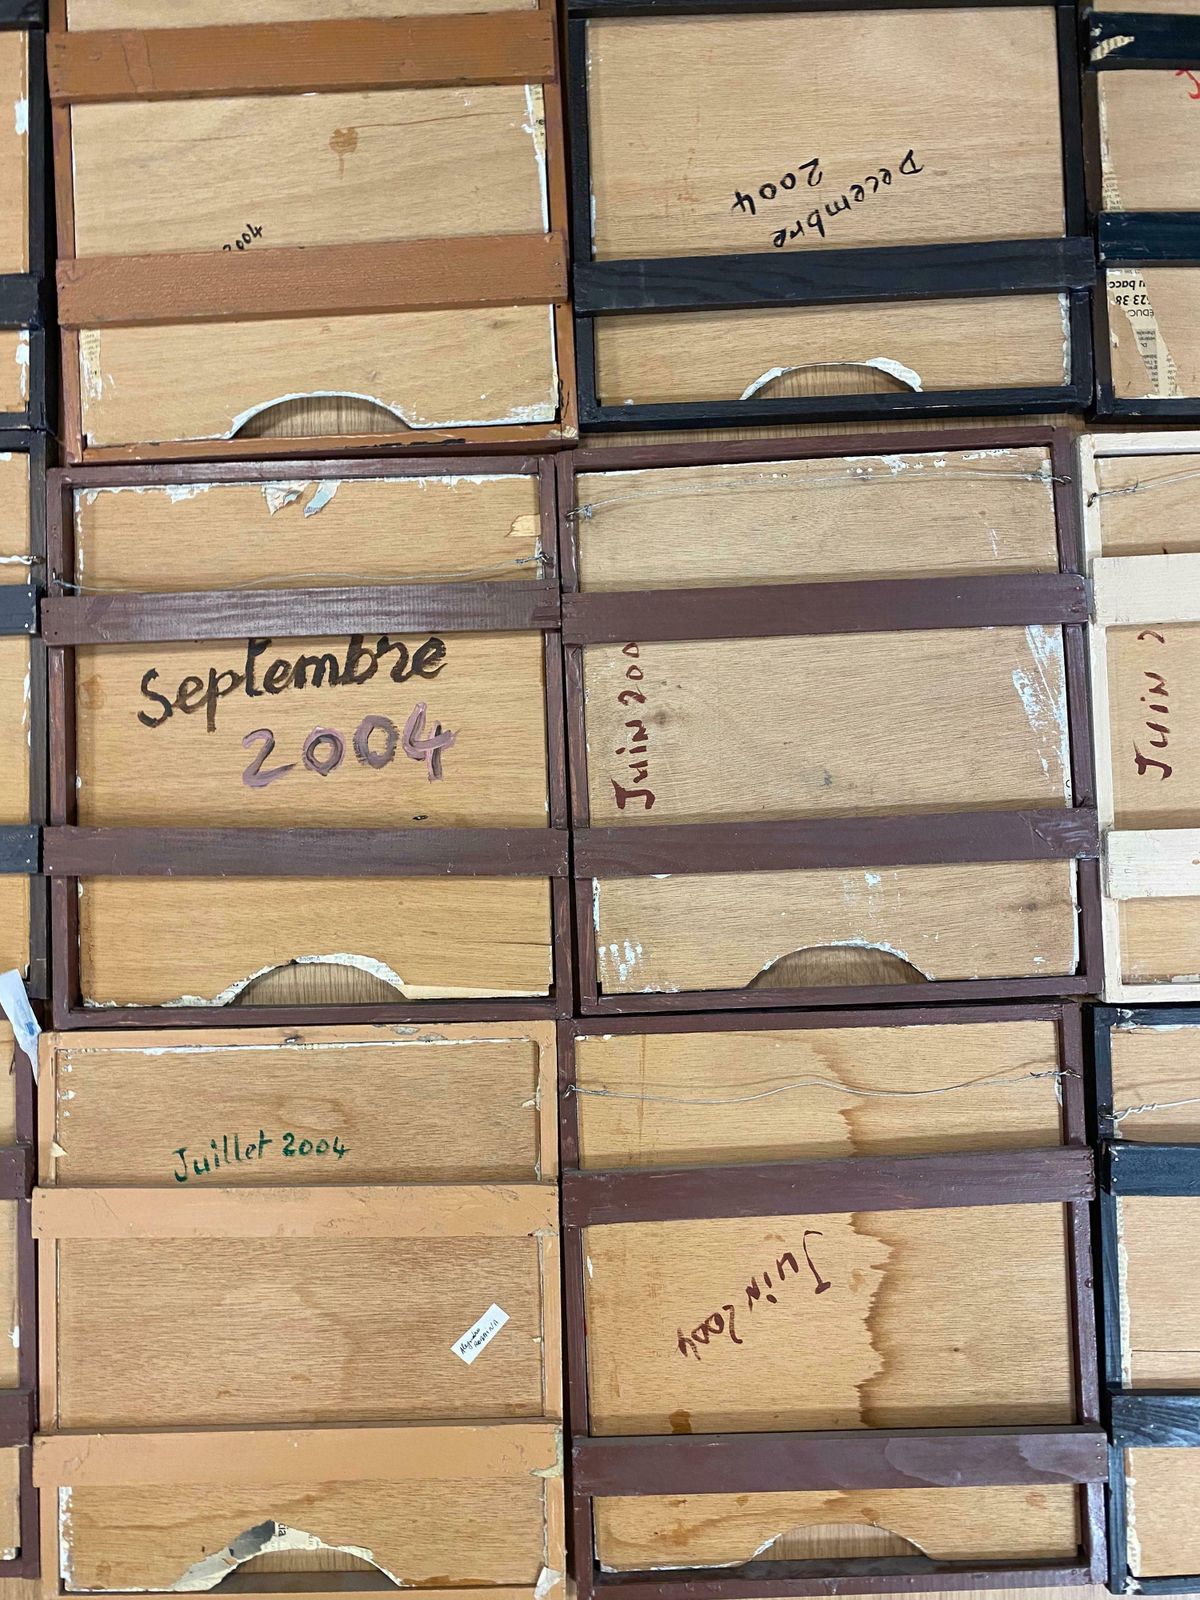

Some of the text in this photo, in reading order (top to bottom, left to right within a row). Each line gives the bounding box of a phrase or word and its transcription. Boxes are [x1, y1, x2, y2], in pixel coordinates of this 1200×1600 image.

[731, 158, 823, 215] 2004
[1133, 294, 1151, 305] 23
[137, 633, 448, 733] Septembre
[242, 701, 460, 788] 2004
[172, 1129, 352, 1183] Juillet 2004
